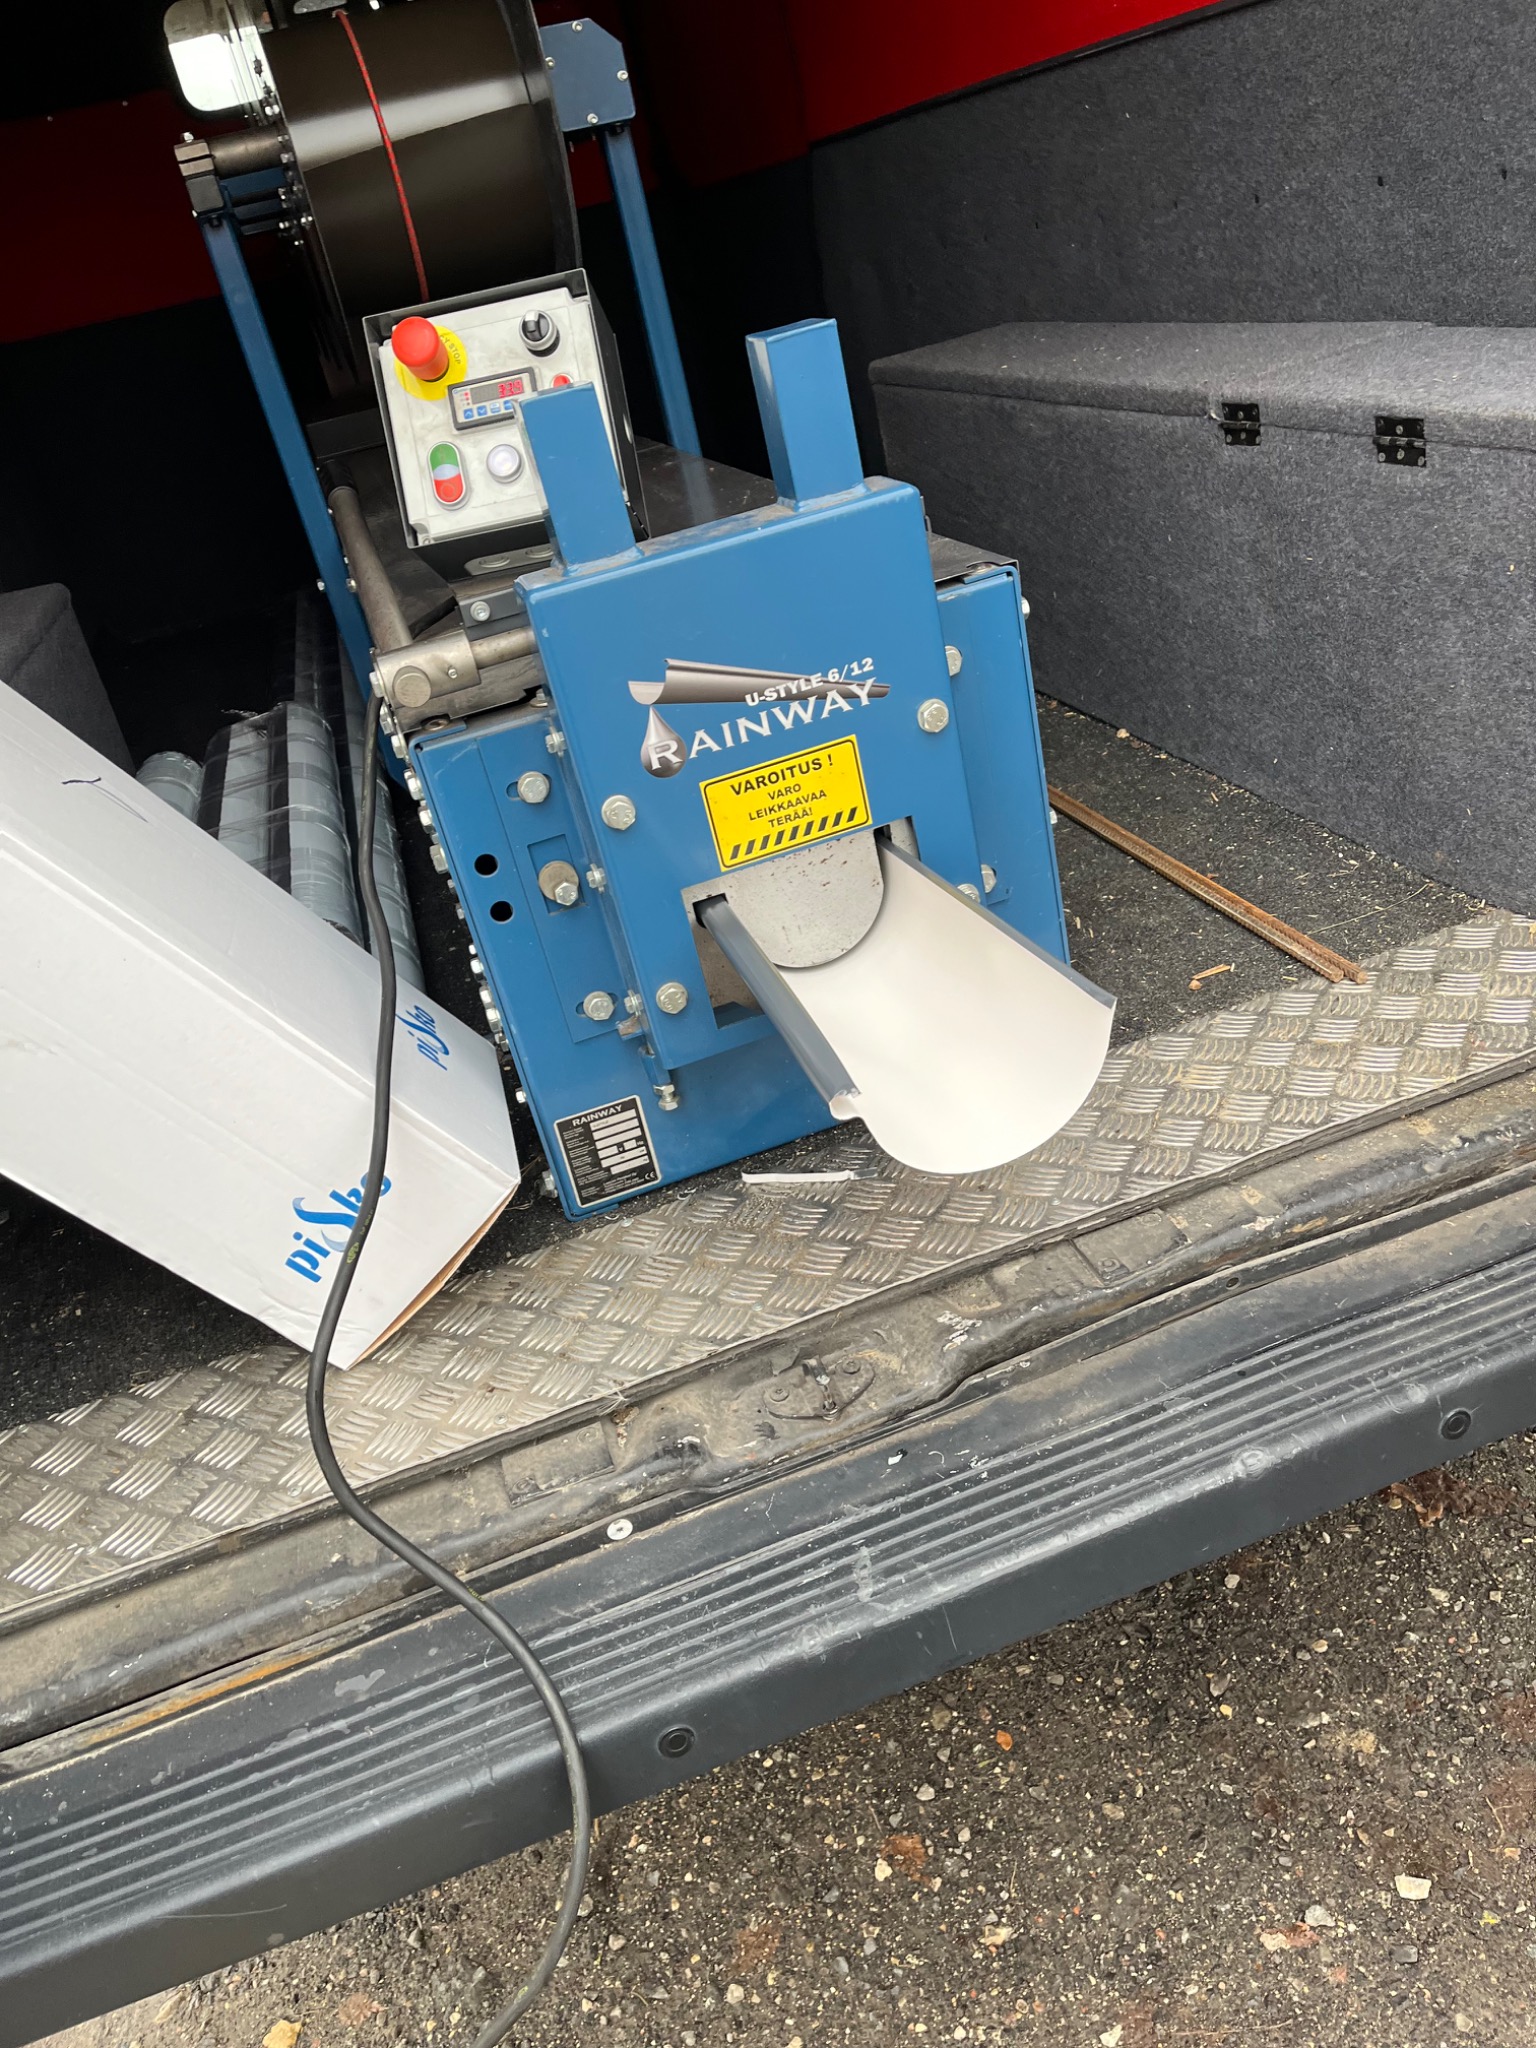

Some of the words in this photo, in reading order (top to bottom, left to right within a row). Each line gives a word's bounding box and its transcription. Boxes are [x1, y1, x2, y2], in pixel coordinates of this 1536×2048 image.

[448, 343, 462, 365] STOP
[744, 671, 824, 707] U-STYLE
[827, 656, 875, 683] 6/12
[650, 677, 878, 771] RAINWAY
[730, 757, 823, 796] VAROITUS
[827, 754, 833, 767] !
[748, 789, 827, 821] LEIKKAAVAA
[768, 783, 802, 801] VARO
[768, 809, 813, 829] TERÄÄ!
[572, 1104, 623, 1127] RAINWAY
